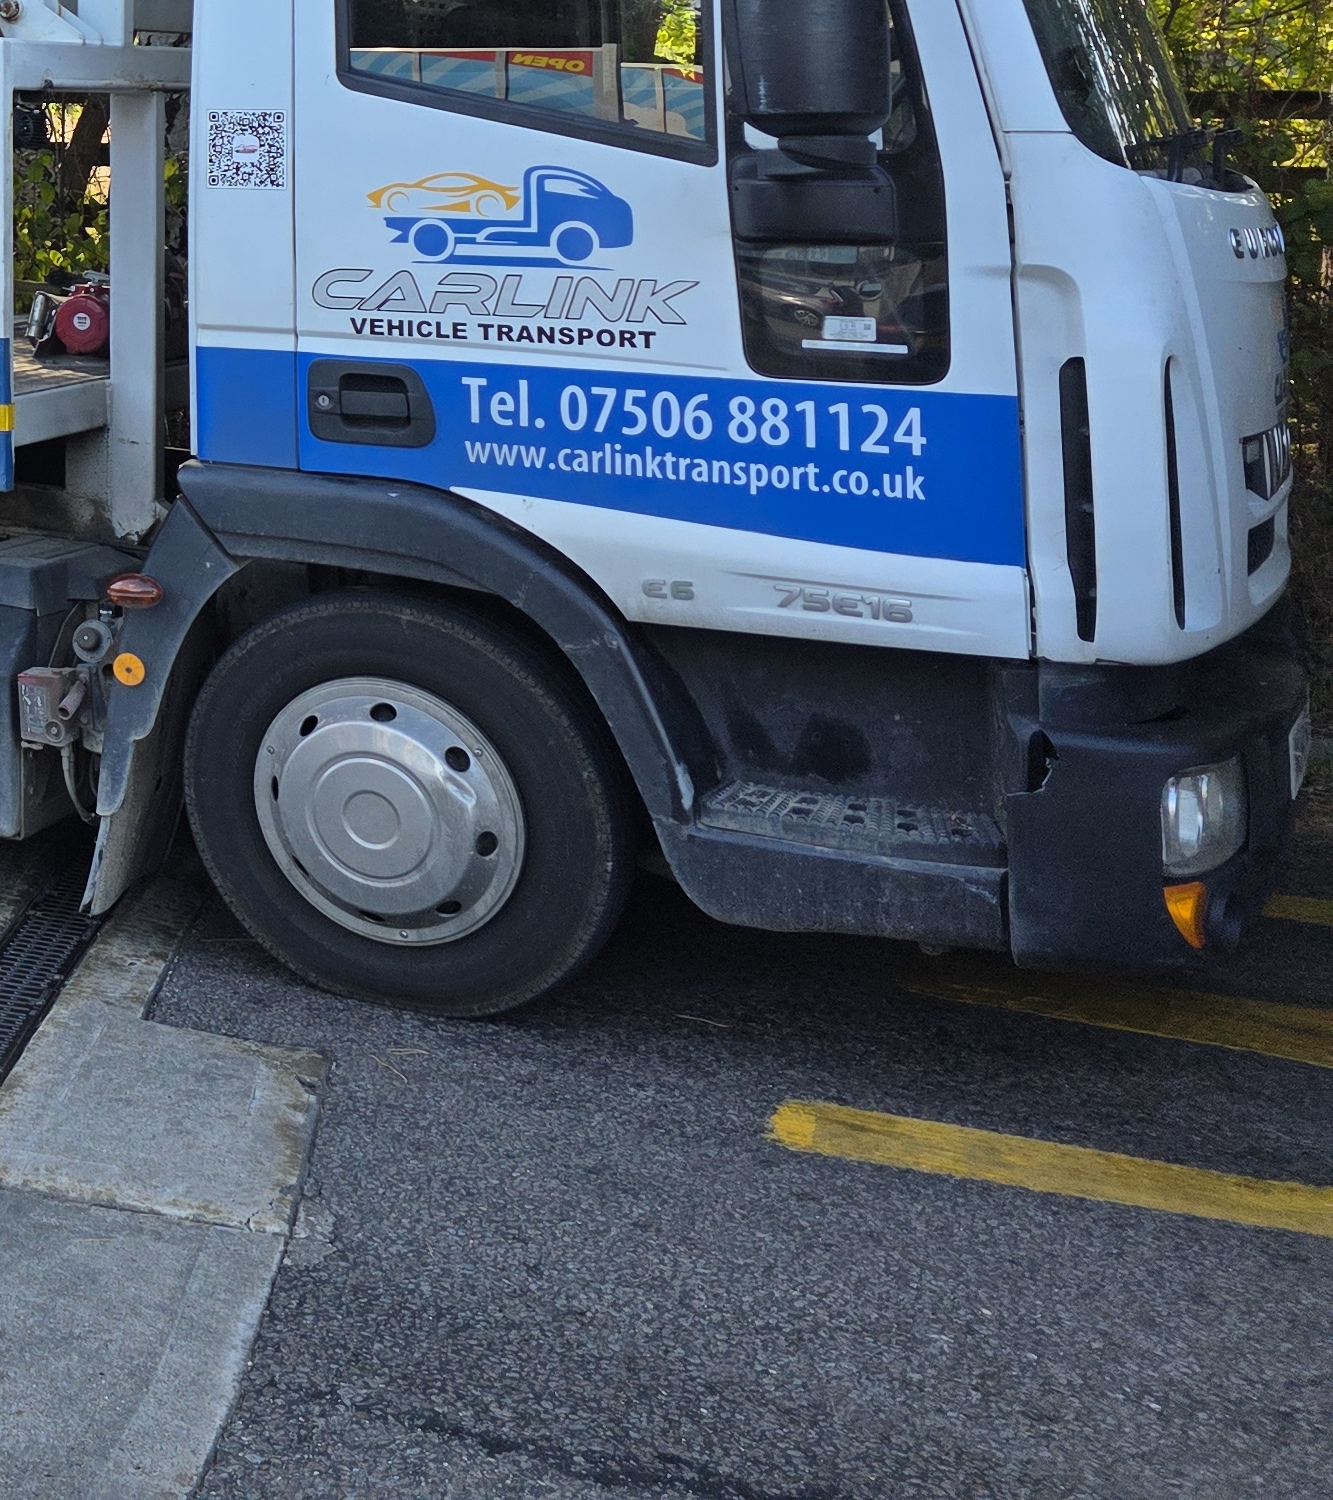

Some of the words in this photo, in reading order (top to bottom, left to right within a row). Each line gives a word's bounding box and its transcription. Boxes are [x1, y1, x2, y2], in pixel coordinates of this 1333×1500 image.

[312, 268, 701, 325] CARLINK
[349, 317, 469, 340] VEHICLE
[477, 322, 657, 349] TRANSPORT
[461, 376, 545, 429] Tel.
[559, 384, 714, 441] 07506
[726, 395, 928, 456] 881124
[464, 439, 927, 501] www.carlinktransport.co.uk
[641, 578, 695, 601] E6
[773, 584, 913, 623] 75E16
